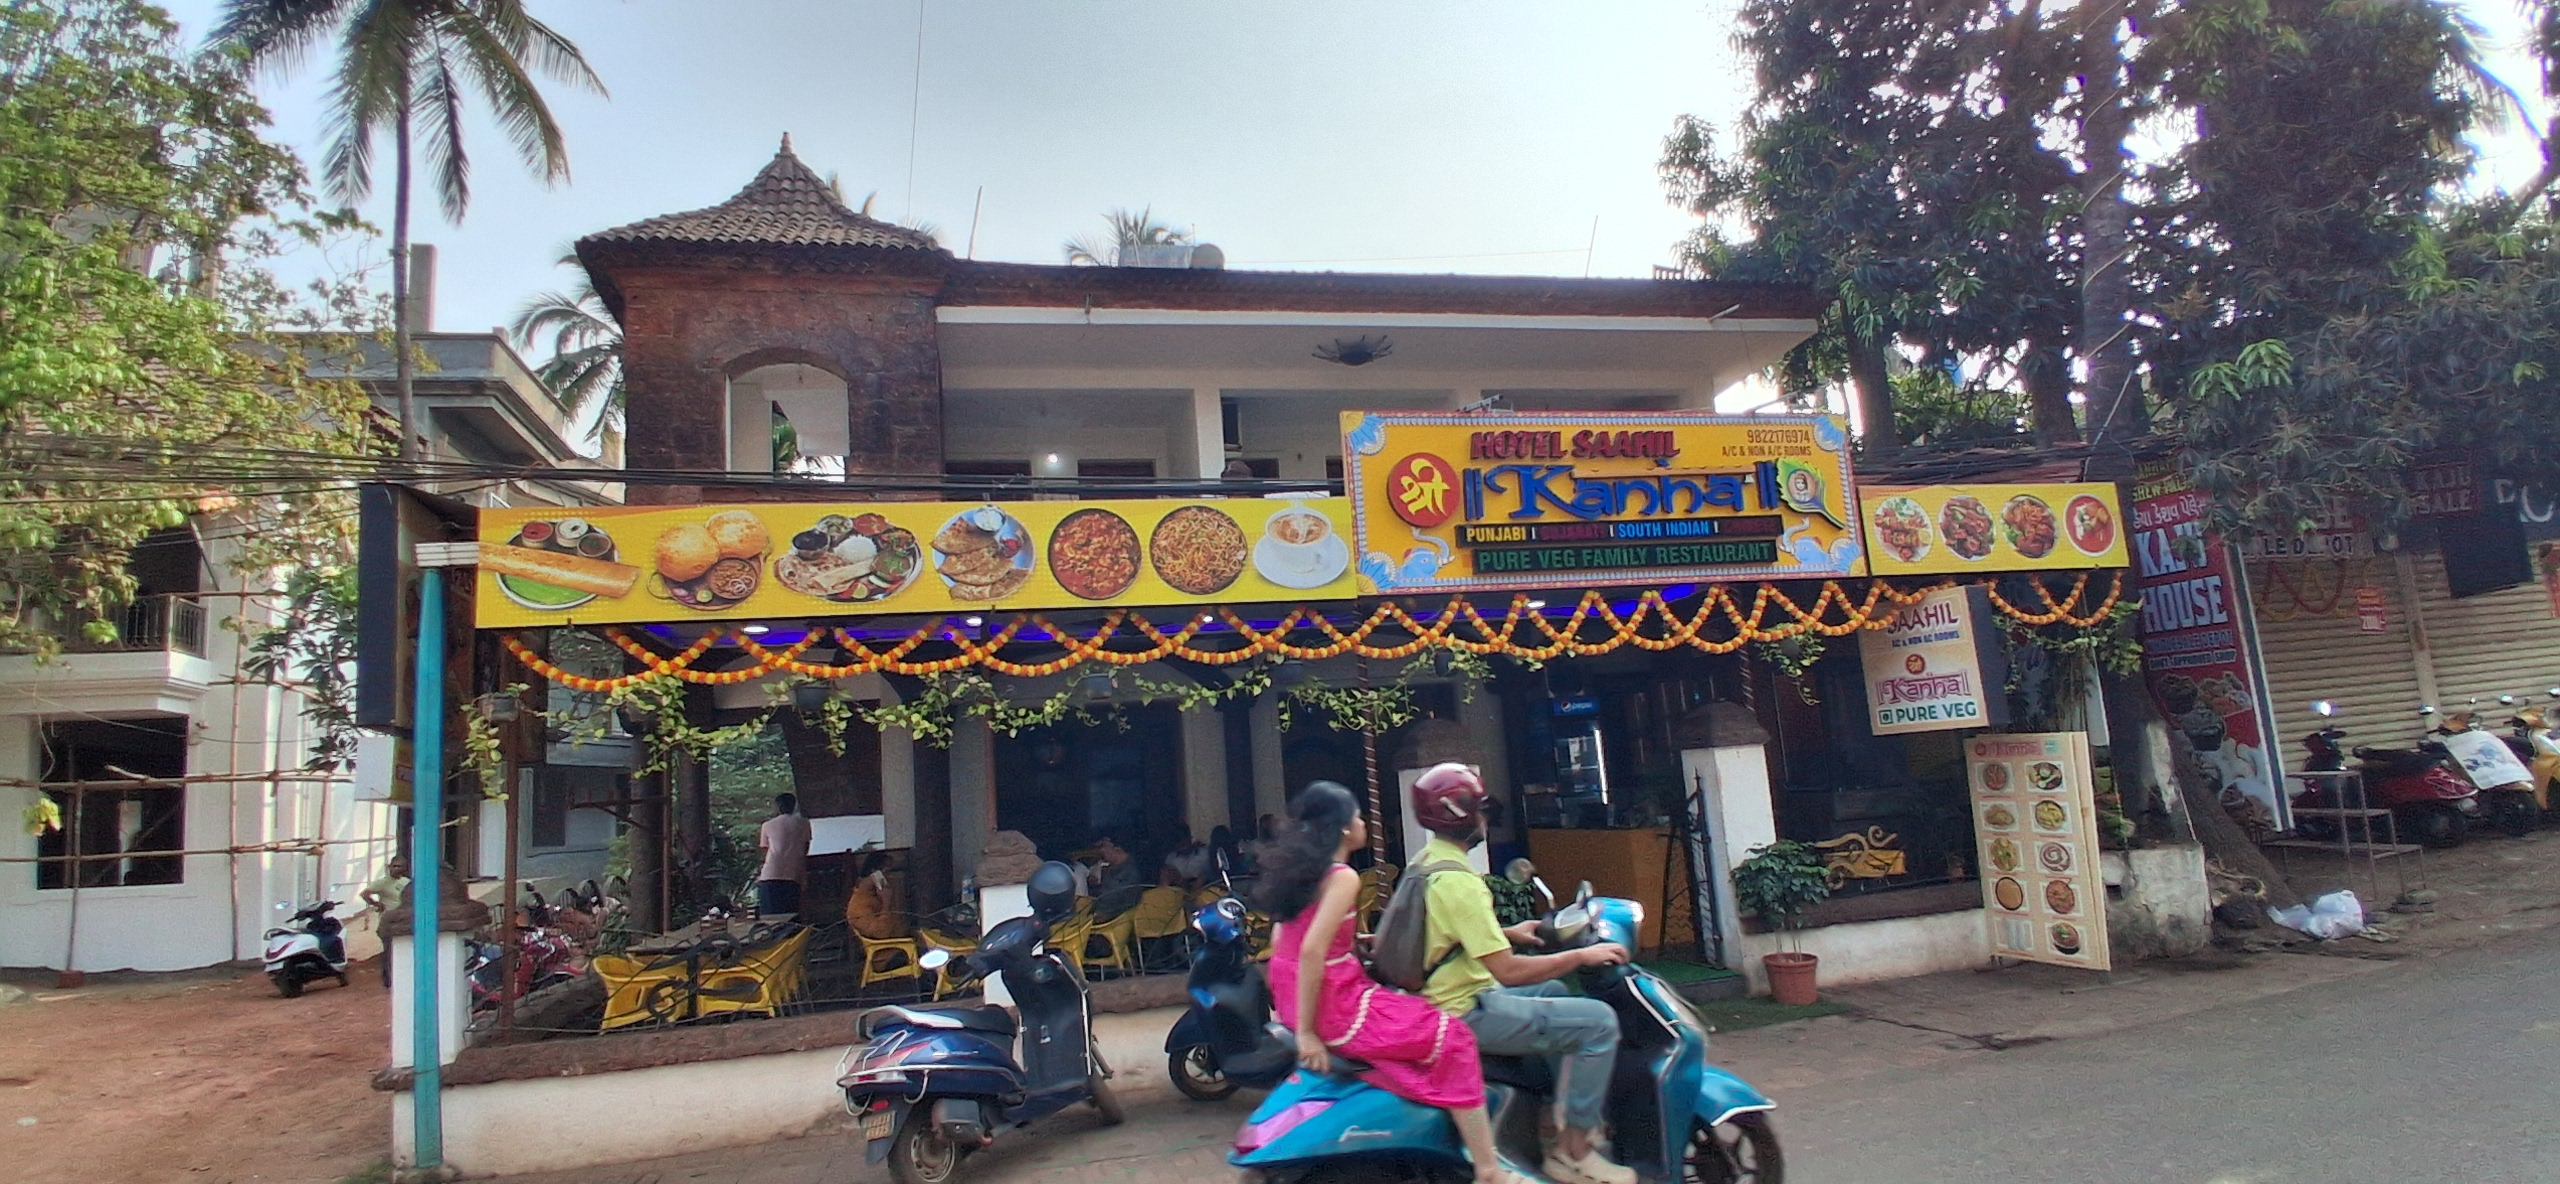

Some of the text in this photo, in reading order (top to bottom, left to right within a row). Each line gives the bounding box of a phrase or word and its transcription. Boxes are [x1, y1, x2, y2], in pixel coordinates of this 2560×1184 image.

[1471, 429, 1681, 459] HOTEL SAAHIL
[1747, 429, 1811, 444] 9822176974
[1722, 446, 1738, 457] A/C
[1748, 446, 1766, 456] NON
[1768, 446, 1783, 456] A/C
[1784, 445, 1812, 457] ROOMS
[1399, 458, 1451, 517] श्री
[1466, 526, 1526, 542] PUNJABI
[1618, 522, 1661, 538] SOUTH
[1665, 521, 1709, 536] INDIAN
[1479, 543, 1771, 571] PURE VEG FAMILY RESTAURANT
[2139, 575, 2229, 633] HOUSE
[1895, 702, 1977, 722] PURE VEG
